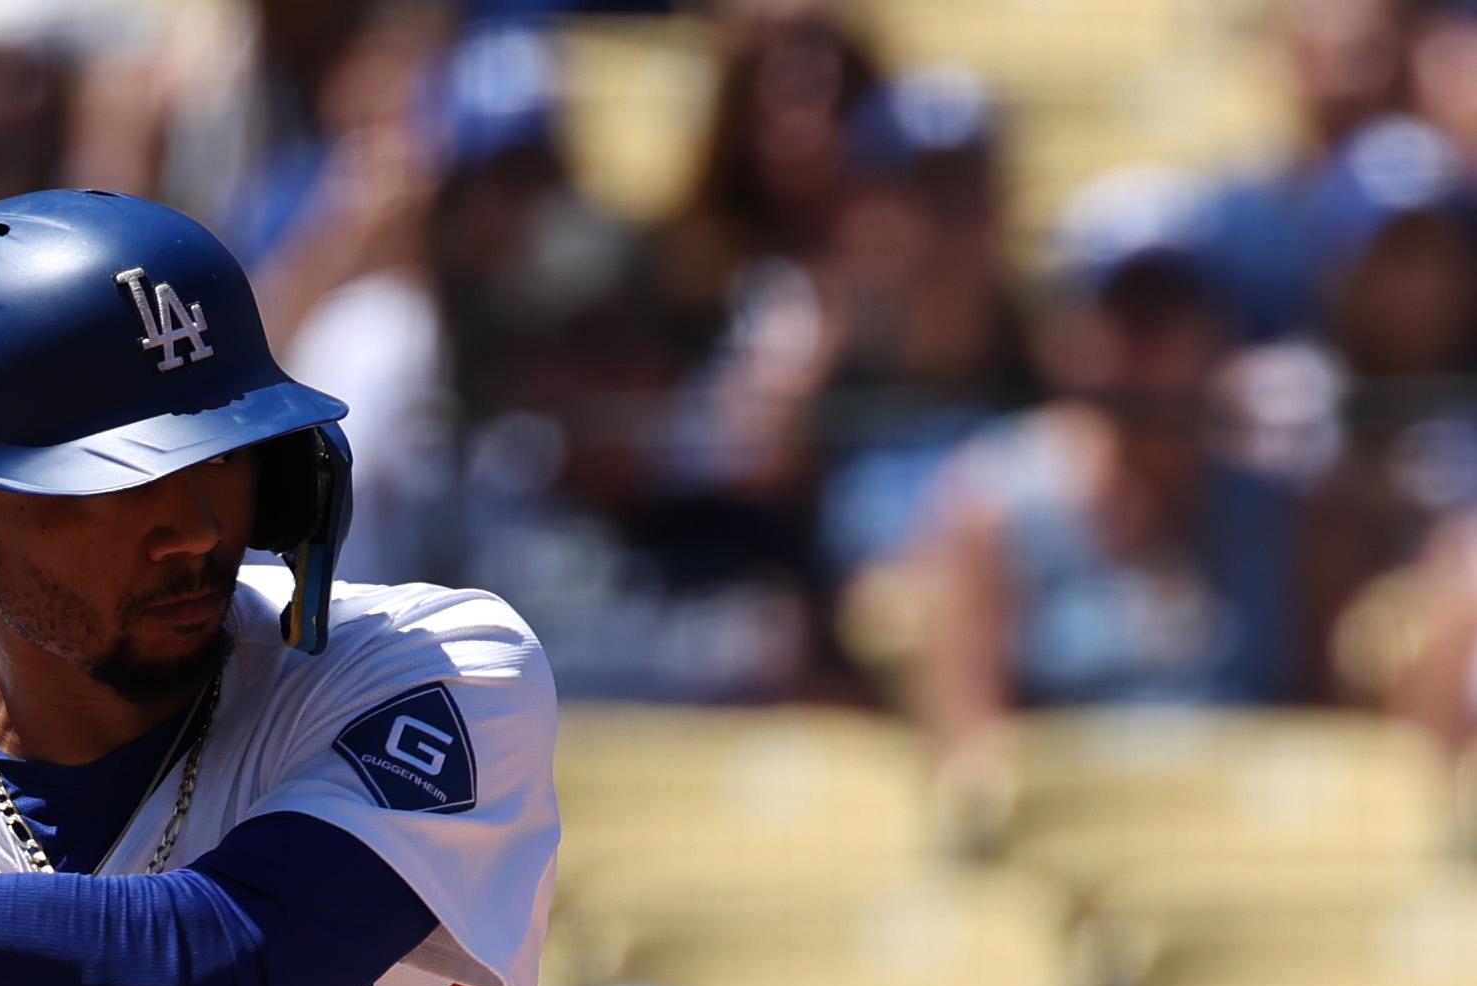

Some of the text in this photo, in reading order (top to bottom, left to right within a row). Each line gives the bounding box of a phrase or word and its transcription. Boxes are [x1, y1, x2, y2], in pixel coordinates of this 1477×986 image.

[113, 266, 215, 373] LA
[385, 714, 454, 776] G
[360, 753, 447, 804] GUGGENHEIM
